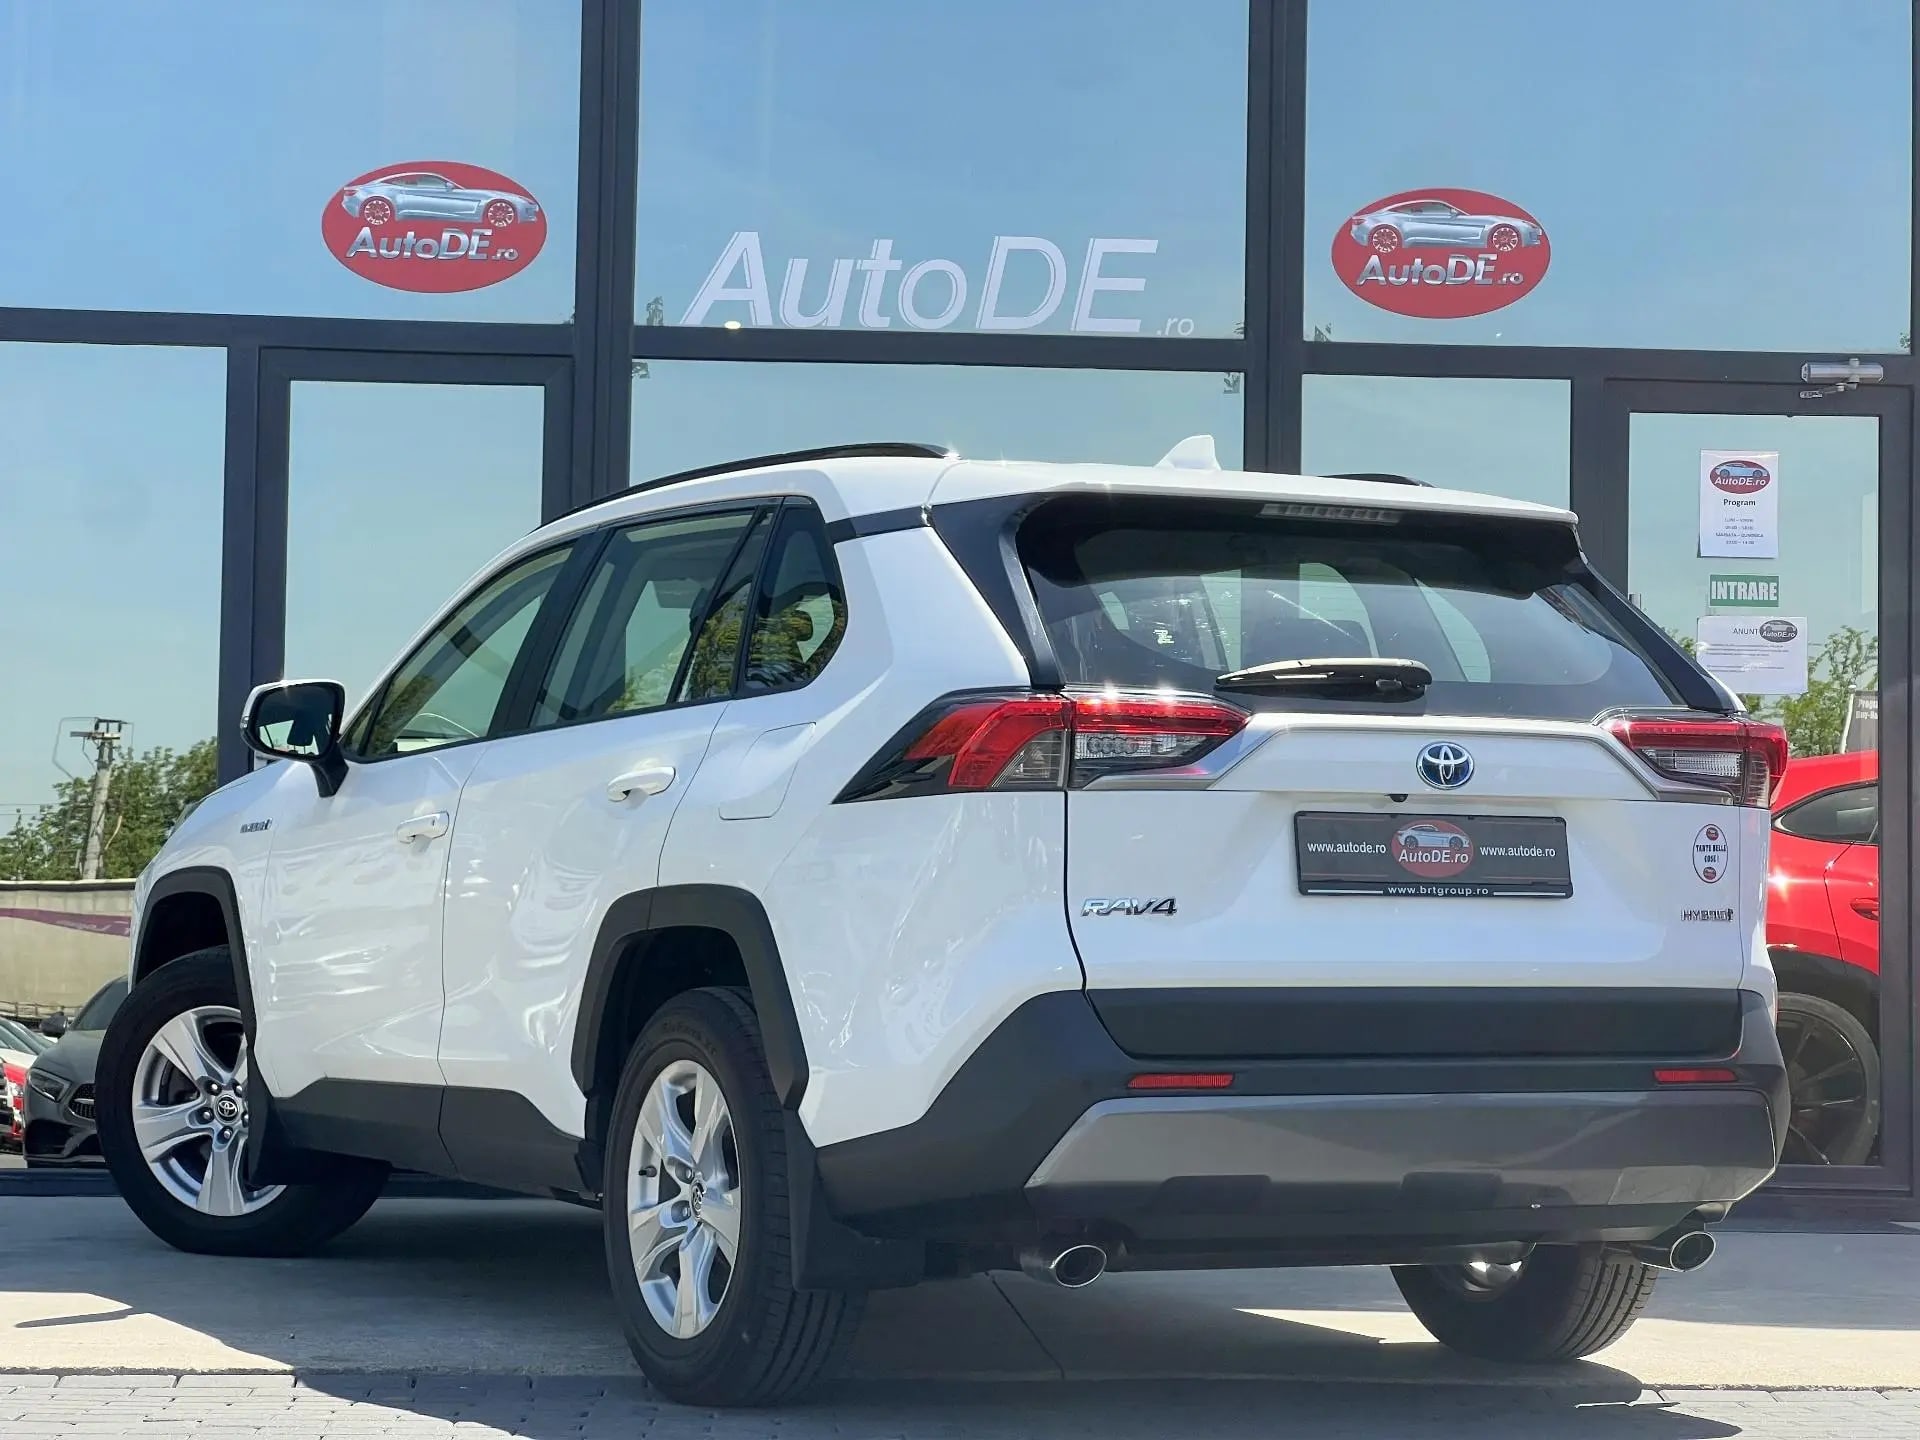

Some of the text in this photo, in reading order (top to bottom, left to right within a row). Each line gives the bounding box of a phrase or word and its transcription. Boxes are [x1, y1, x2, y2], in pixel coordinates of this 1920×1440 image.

[1714, 476, 1767, 487] AutoDE.ro
[1723, 499, 1756, 508] Program
[1711, 581, 1778, 600] INTRARE
[1307, 841, 1387, 855] www.autode.ro
[1480, 844, 1556, 858] www.autode.ro
[1398, 849, 1470, 864] AutoDE.ro
[1387, 885, 1489, 897] www.brtgroup.ro
[1081, 897, 1178, 917] RAV4
